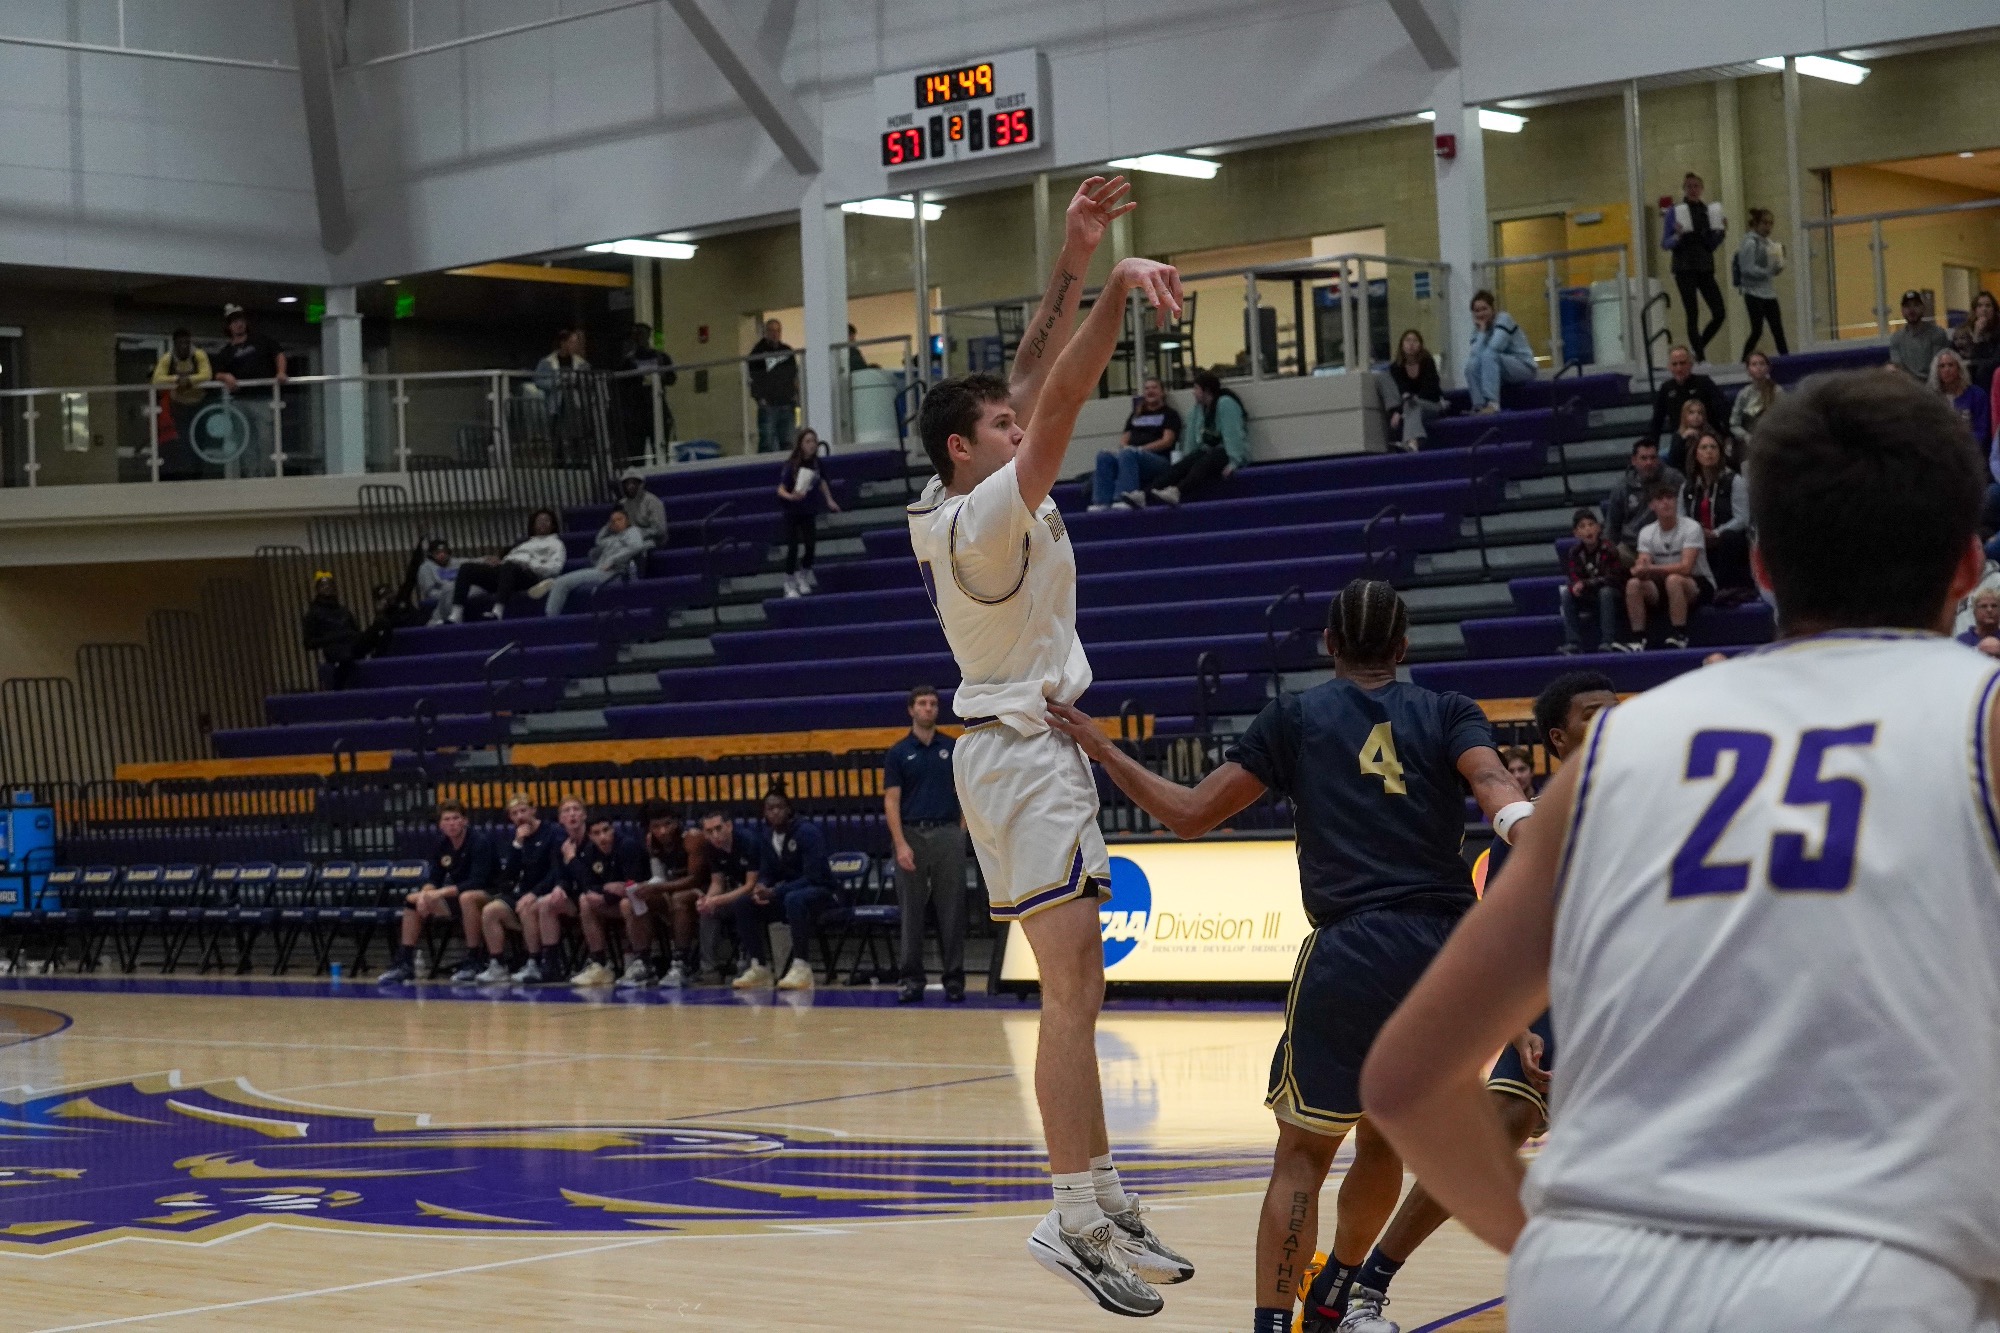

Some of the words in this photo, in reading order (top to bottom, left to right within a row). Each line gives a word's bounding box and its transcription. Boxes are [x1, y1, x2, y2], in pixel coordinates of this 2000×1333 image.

[886, 128, 921, 165] 57
[950, 115, 963, 140] 2
[996, 109, 1029, 147] 35
[1030, 328, 1048, 358] Bet
[1046, 316, 1056, 330] on
[1053, 268, 1077, 318] yourself
[1358, 720, 1408, 795] 4
[1666, 720, 1880, 903] 25
[1155, 911, 1254, 941] Division
[1262, 911, 1281, 940] III
[1276, 1191, 1309, 1294] BREATHE
